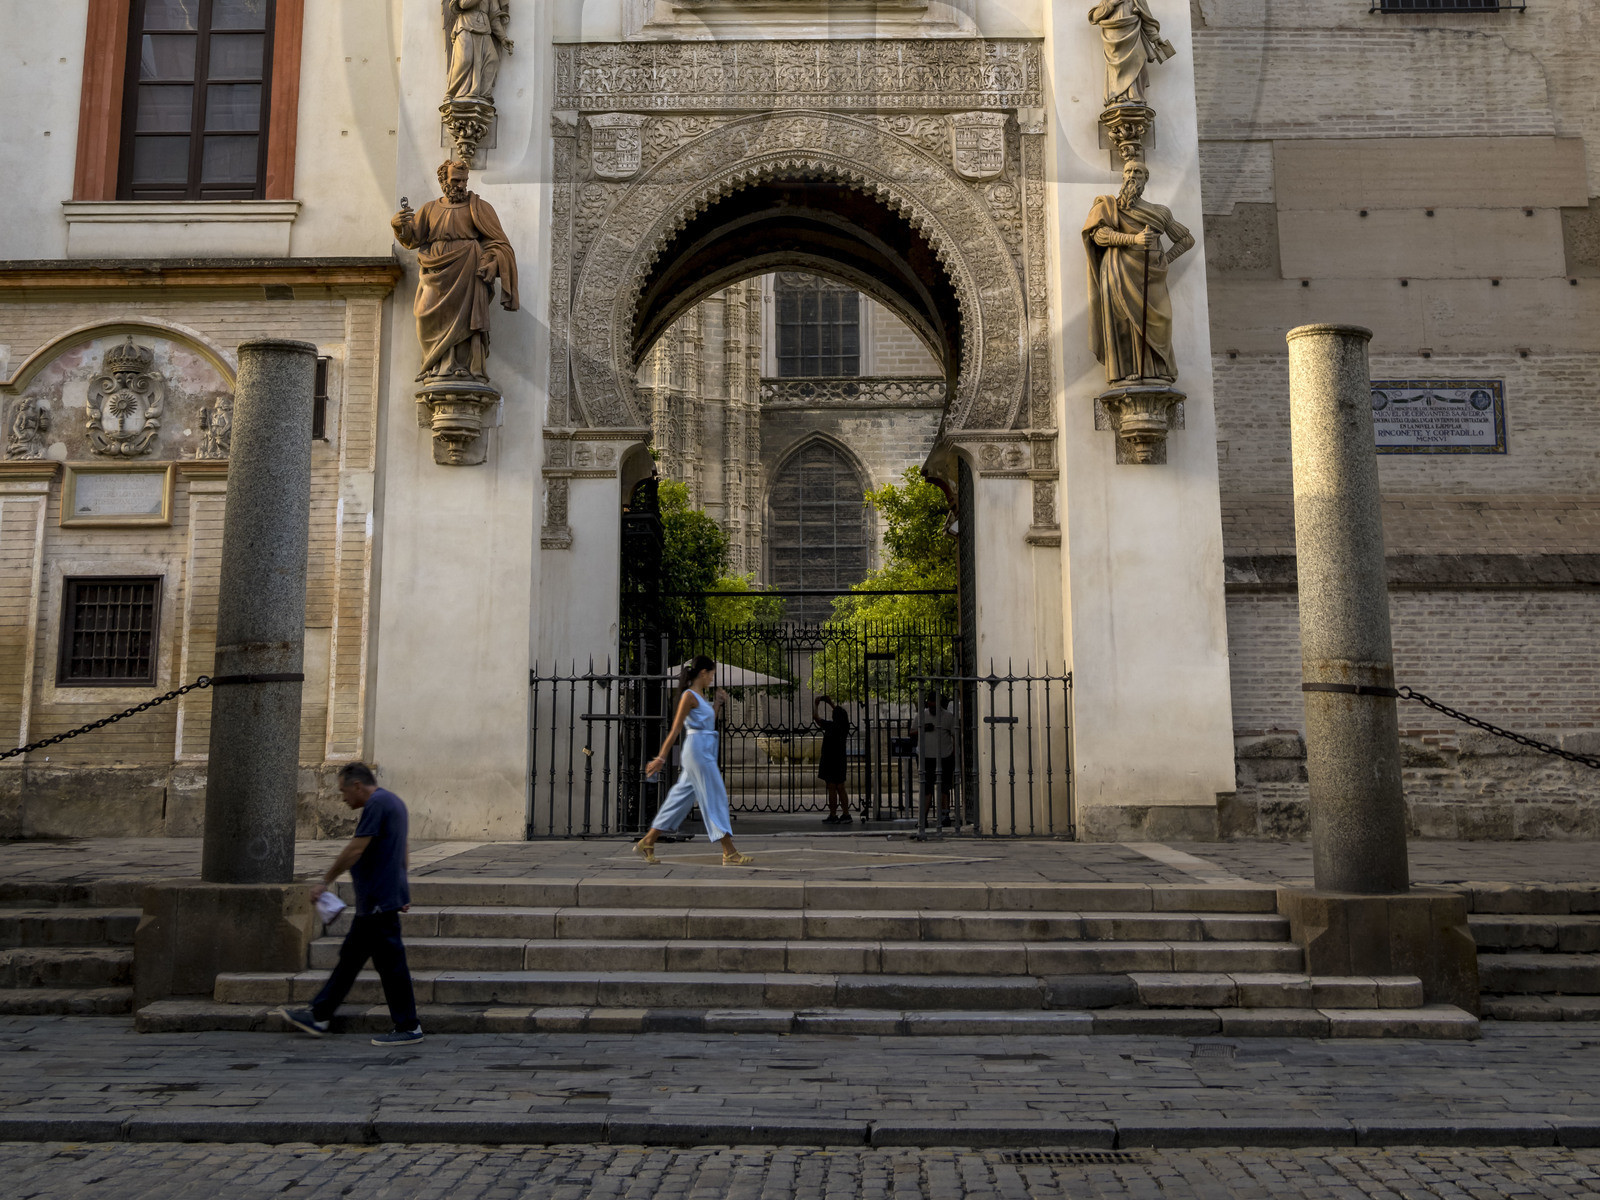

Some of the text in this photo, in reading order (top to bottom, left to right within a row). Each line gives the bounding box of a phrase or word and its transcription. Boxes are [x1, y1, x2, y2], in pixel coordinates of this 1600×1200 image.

[1378, 429, 1484, 437] RINCONETE Y CORTADILLO
